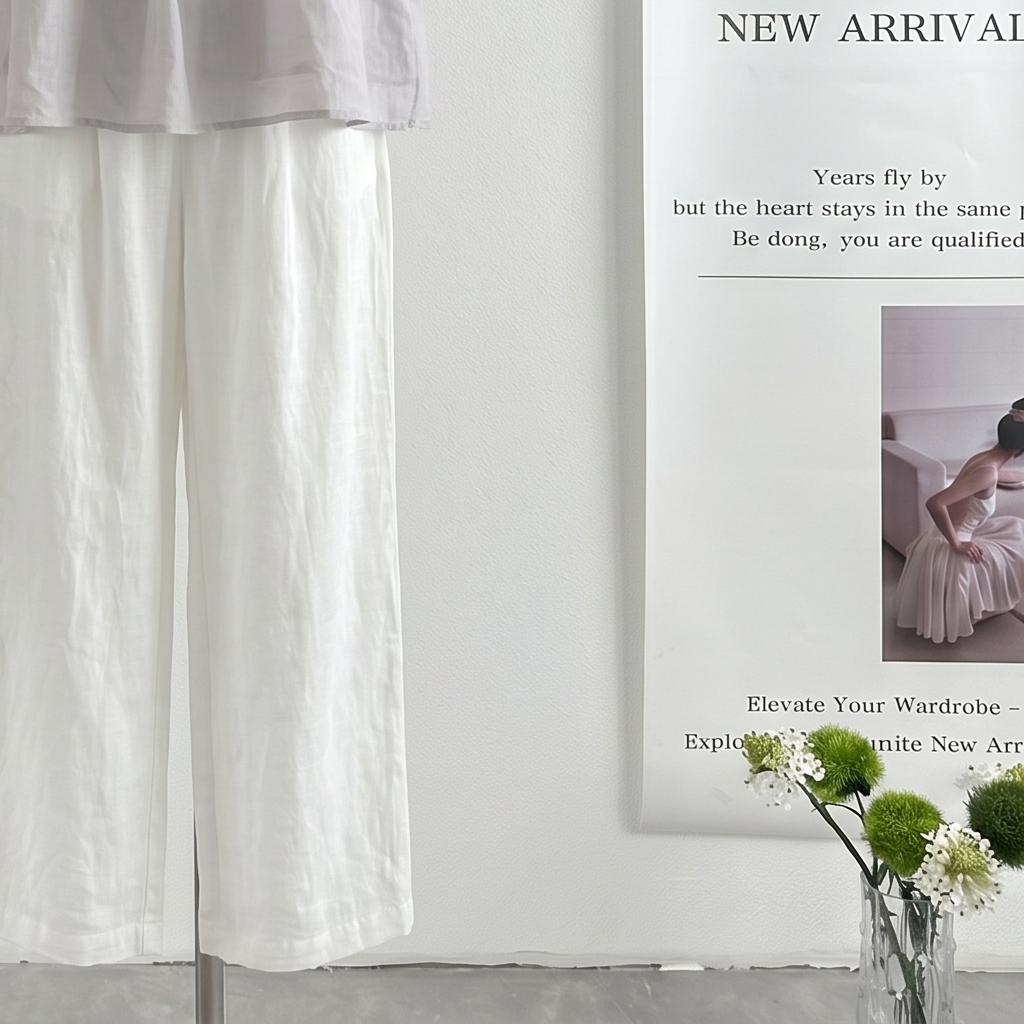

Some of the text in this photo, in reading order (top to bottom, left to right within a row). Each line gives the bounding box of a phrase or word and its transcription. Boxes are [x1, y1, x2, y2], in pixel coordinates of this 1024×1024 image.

[717, 12, 1024, 44] NEW ARRIVAL
[812, 167, 948, 192] Years fly by
[672, 198, 707, 216] but
[714, 198, 748, 217] the
[755, 198, 814, 217] heart
[821, 201, 877, 223] stays
[884, 199, 906, 217] in
[914, 199, 949, 218] the
[956, 204, 1012, 218] same
[732, 229, 1024, 253] Be dong, you are qualified
[746, 695, 826, 714] Elevate
[832, 695, 887, 714] Your
[893, 696, 1002, 717] Wardrobe
[683, 732, 744, 754] Explo
[930, 734, 978, 754] New
[985, 736, 1024, 755] Arr
